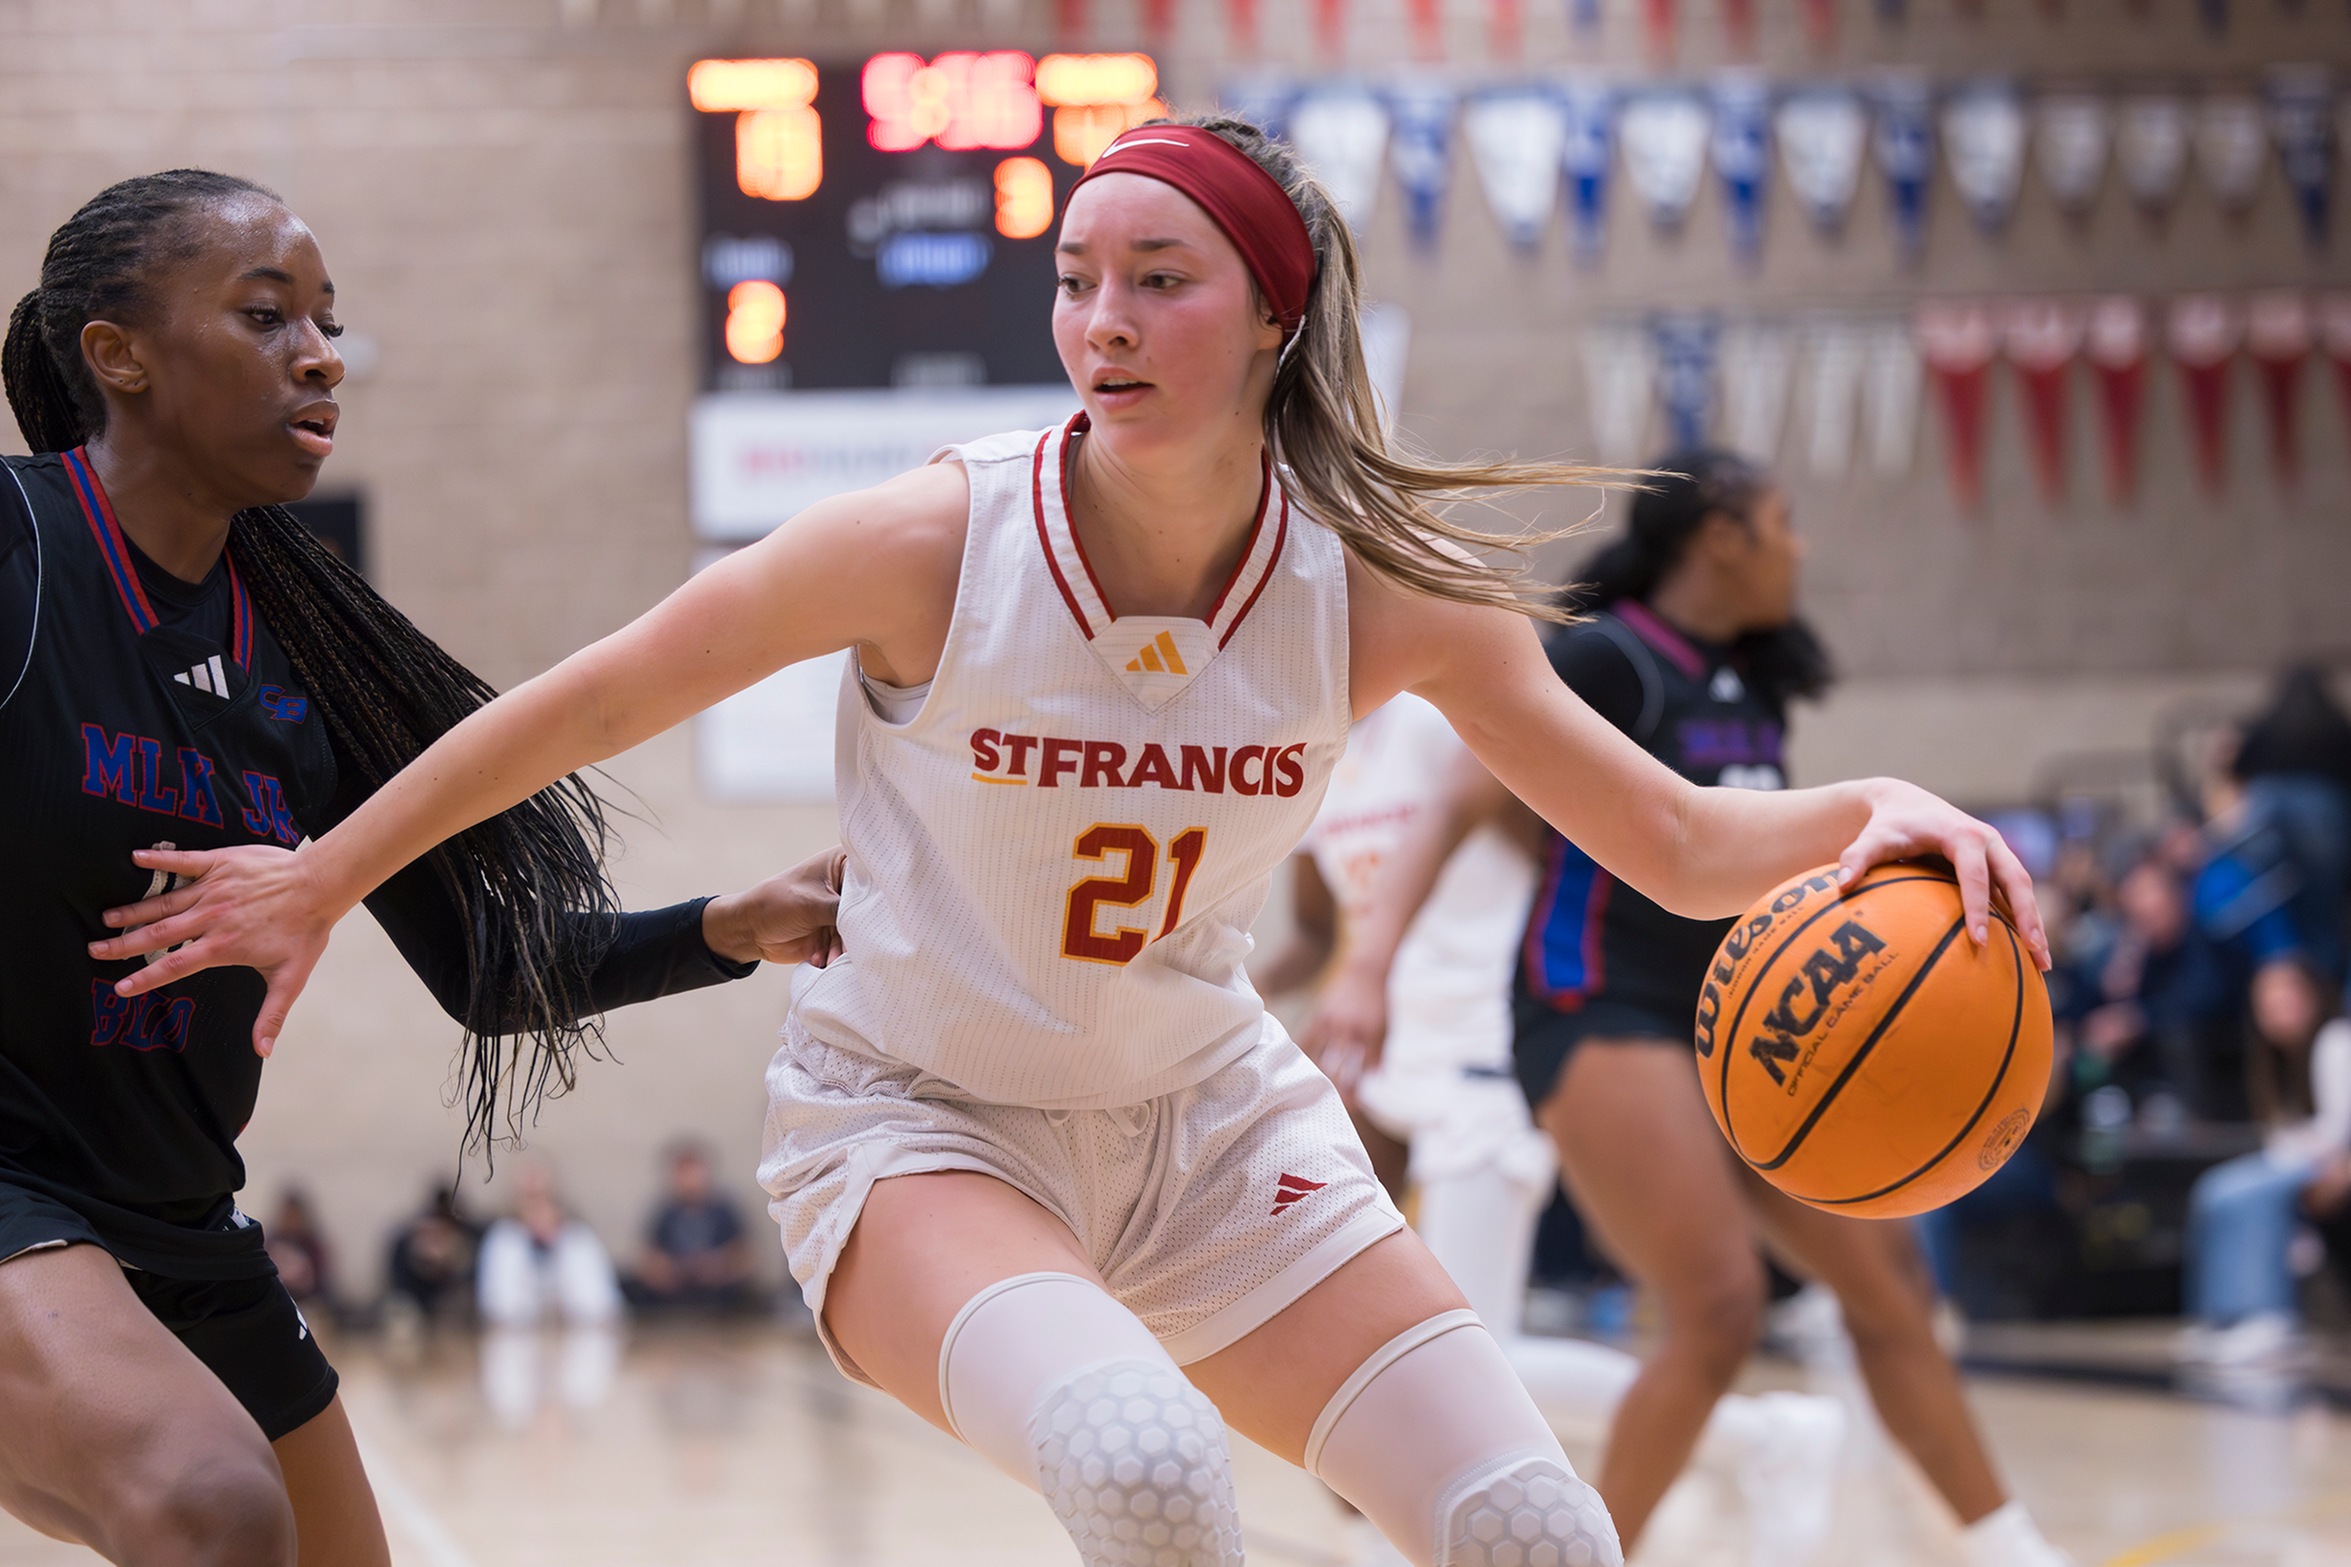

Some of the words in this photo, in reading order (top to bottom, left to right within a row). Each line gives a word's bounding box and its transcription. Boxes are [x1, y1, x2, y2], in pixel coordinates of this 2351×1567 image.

[81, 723, 224, 829] MLK
[242, 770, 299, 845] JR
[1060, 822, 1208, 966] 21
[1748, 920, 1887, 1087] NCAA
[1787, 1032, 1828, 1097] OFFICIAL
[1826, 984, 1864, 1028] GAME
[1864, 951, 1899, 984] BALL
